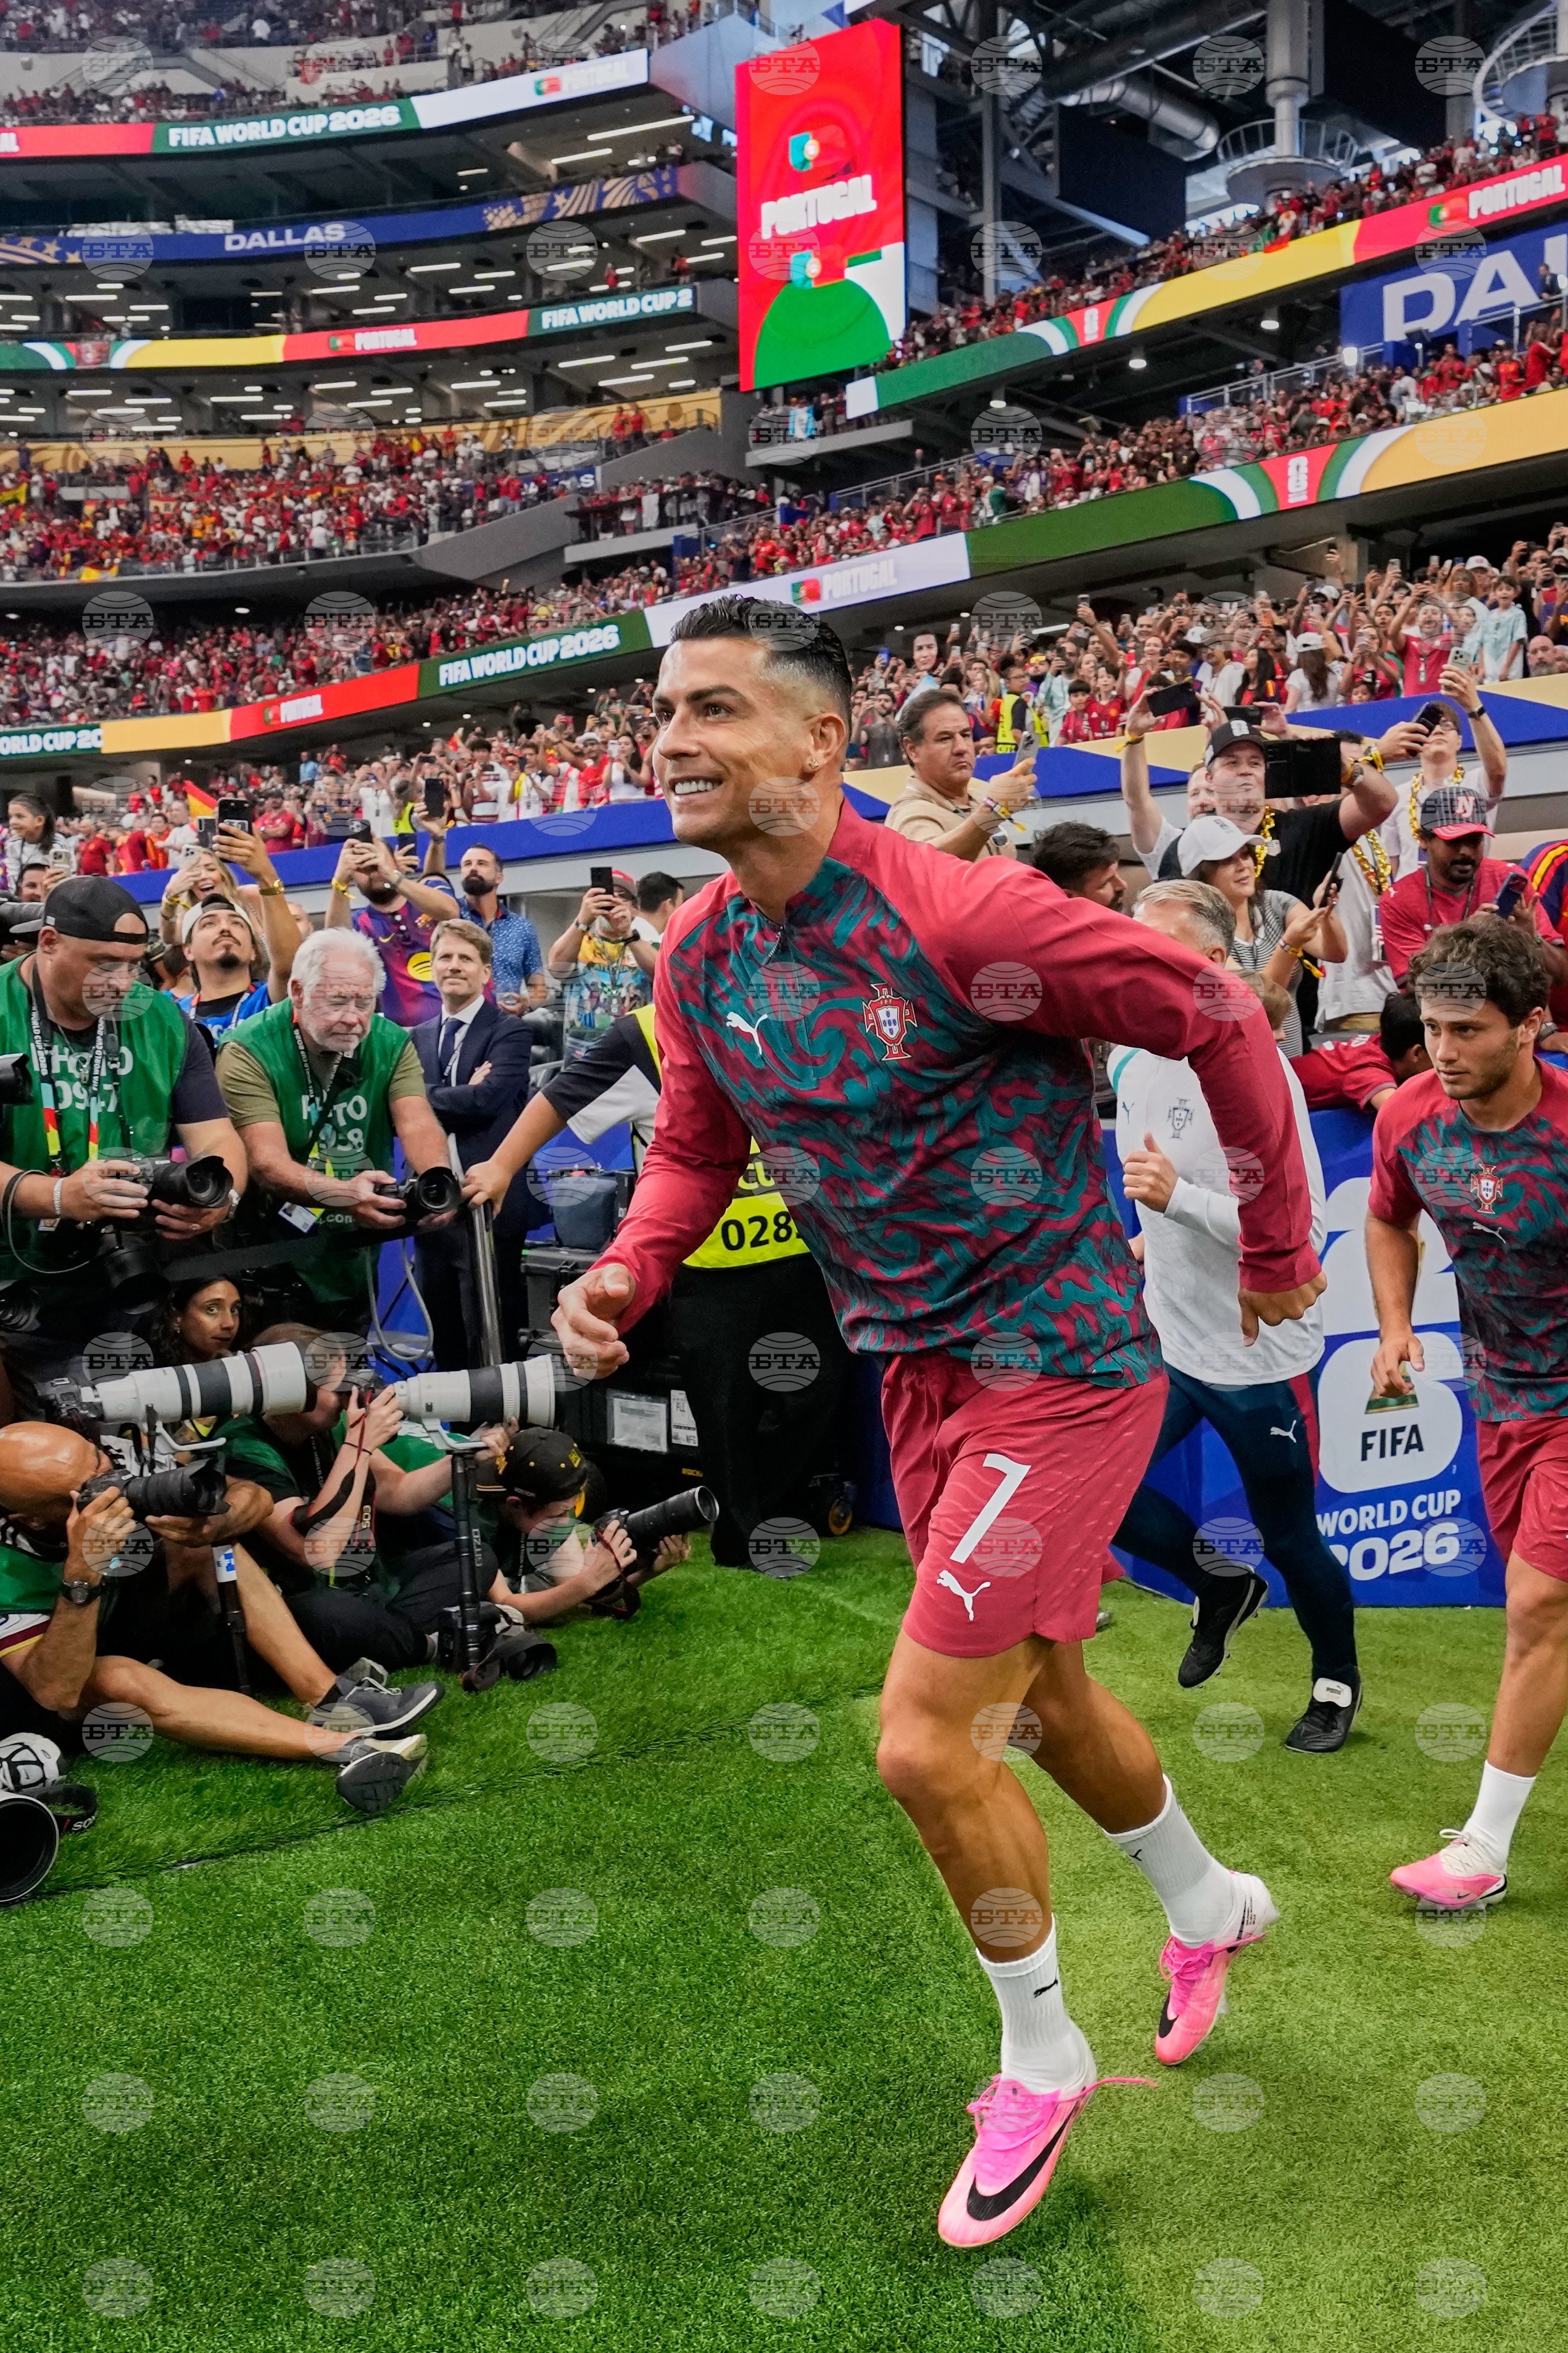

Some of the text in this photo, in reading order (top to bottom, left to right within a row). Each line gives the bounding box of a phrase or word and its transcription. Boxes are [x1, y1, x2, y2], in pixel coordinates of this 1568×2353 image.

[168, 105, 402, 147] FIFA WORLD CUP 2026
[761, 174, 877, 240] PORTUGAL
[1469, 165, 1566, 219] PORTUGAL
[225, 223, 346, 251] DALLAS
[541, 307, 579, 329] FIFA
[578, 297, 641, 323] WORLD
[641, 291, 677, 313] CUP
[823, 559, 898, 601] PORTUGAL
[439, 624, 621, 686] FIFA WORLD CUP 2026
[43, 731, 77, 752] CUP
[1454, 796, 1475, 818] N
[93, 1050, 103, 1075] WORLD
[96, 1036, 104, 1050] CUP
[92, 1075, 100, 1091] FIFA
[721, 1211, 802, 1251] 028
[1361, 1424, 1424, 1462] FIFA
[949, 1453, 1032, 1564] 7
[1316, 1489, 1461, 1537] WORLD CUP
